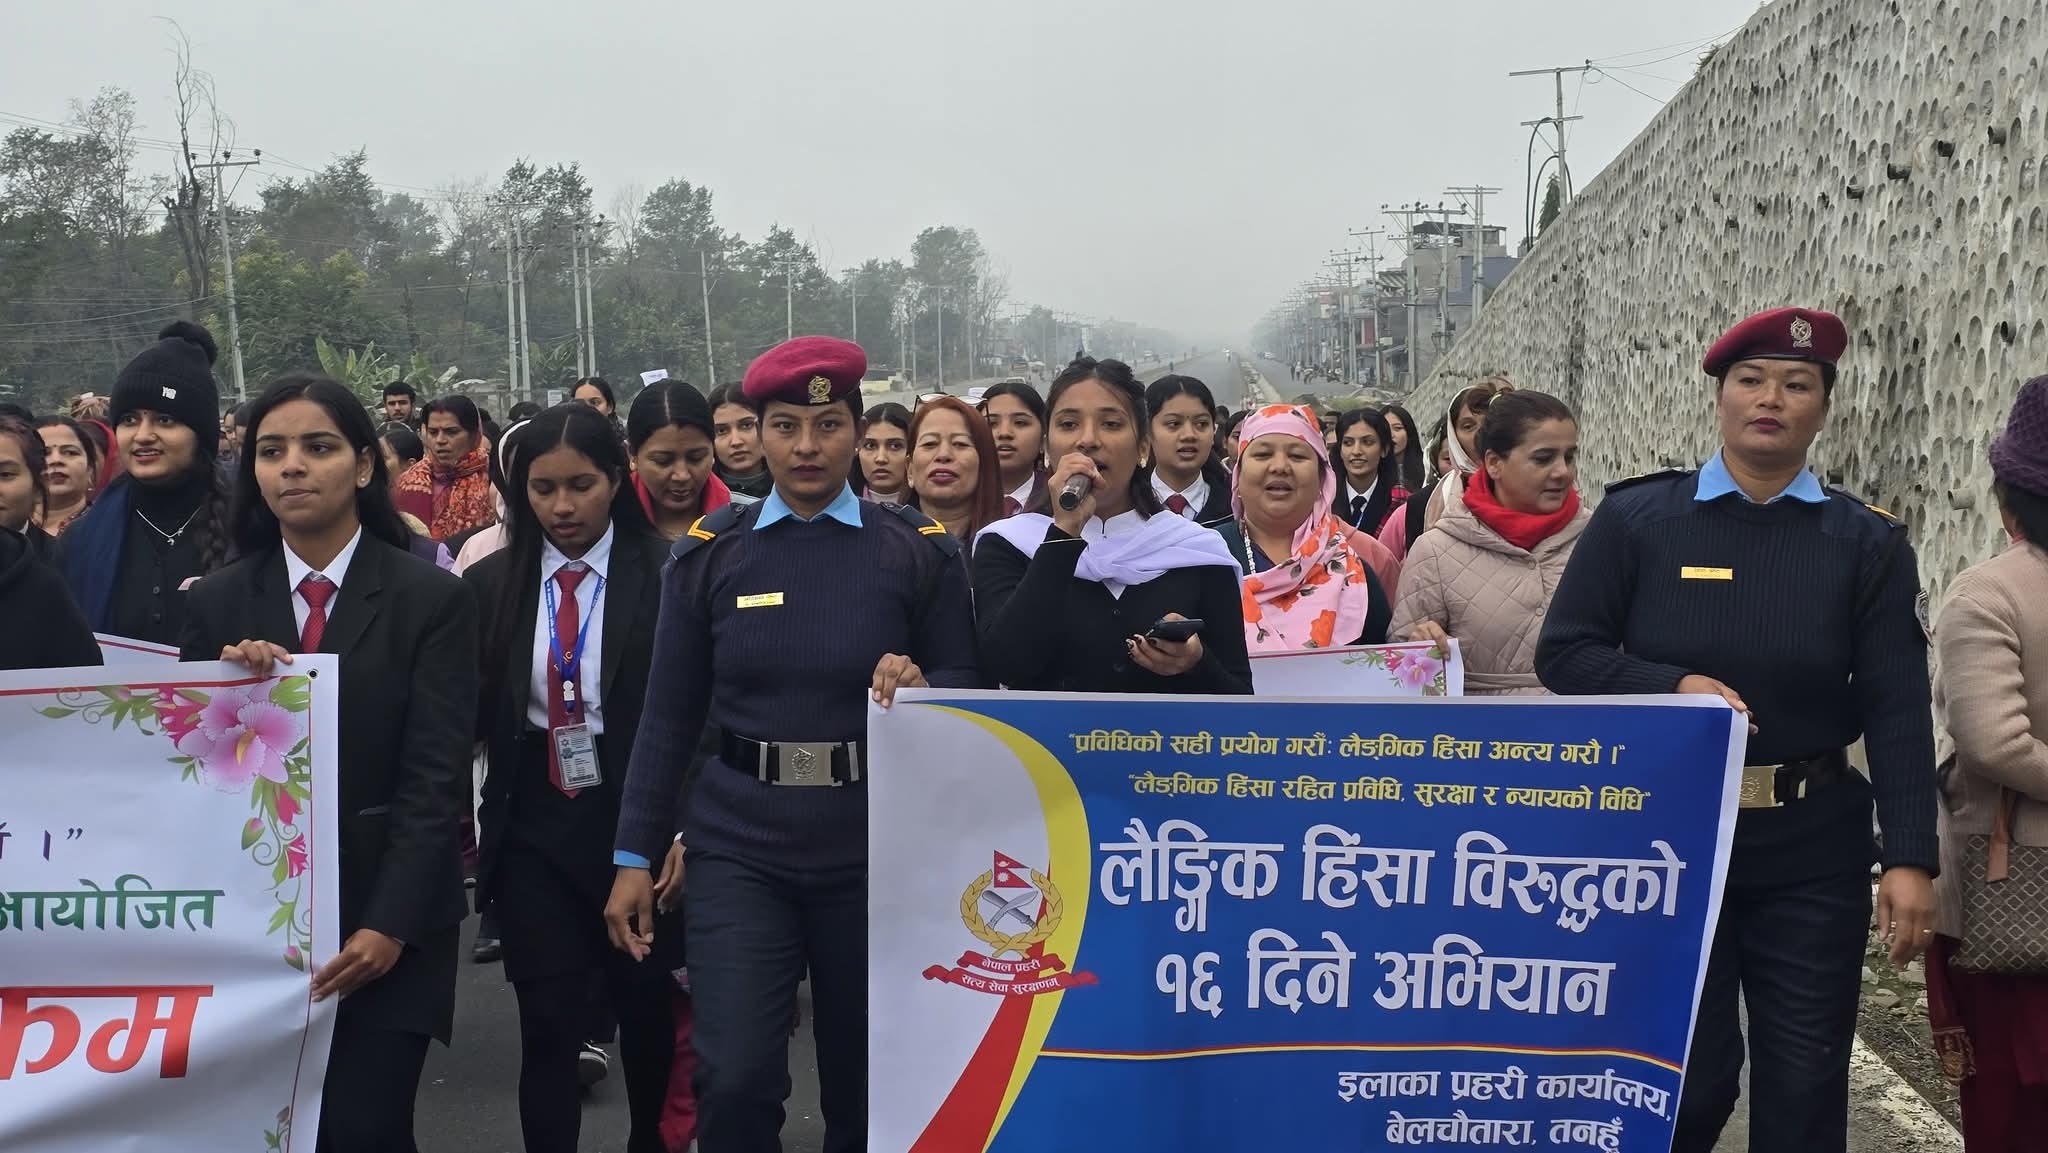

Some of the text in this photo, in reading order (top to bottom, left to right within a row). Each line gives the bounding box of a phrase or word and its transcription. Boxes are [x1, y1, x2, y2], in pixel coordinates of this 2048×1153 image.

[1170, 731, 1214, 754] सही
[1220, 732, 1280, 756] प्रयोग
[1432, 734, 1483, 760] हिंसा
[1488, 741, 1555, 762] अन्त्य
[1560, 738, 1603, 765] गरौ
[1226, 773, 1276, 798] हिंसा
[1282, 775, 1336, 800] रहित
[1413, 783, 1477, 808] सुरक्षा
[1483, 786, 1500, 806] र
[1506, 785, 1594, 810] न्यायको
[1302, 824, 1435, 909] हिंसा
[1155, 928, 1616, 1018] १६ दिने अभियान
[1338, 1071, 1441, 1102] इलाका
[1451, 1065, 1528, 1101] प्रहरी
